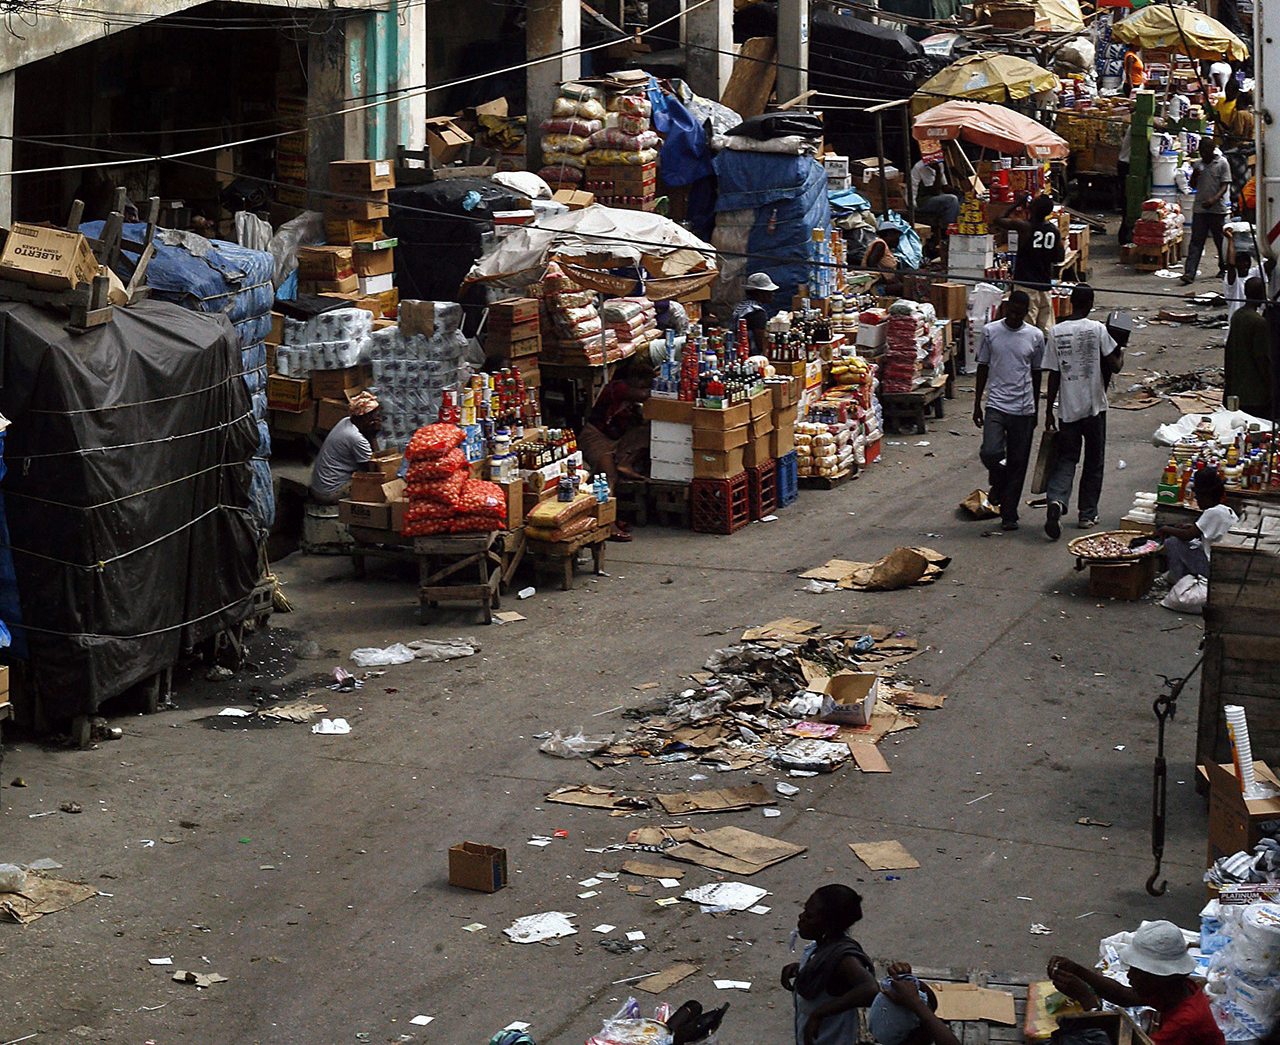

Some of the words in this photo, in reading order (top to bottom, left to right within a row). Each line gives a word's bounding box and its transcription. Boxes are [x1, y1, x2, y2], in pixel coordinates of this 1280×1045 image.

[1032, 231, 1056, 249] 20
[14, 247, 63, 261] ALBERTO
[1220, 892, 1260, 901] PLATINUM
